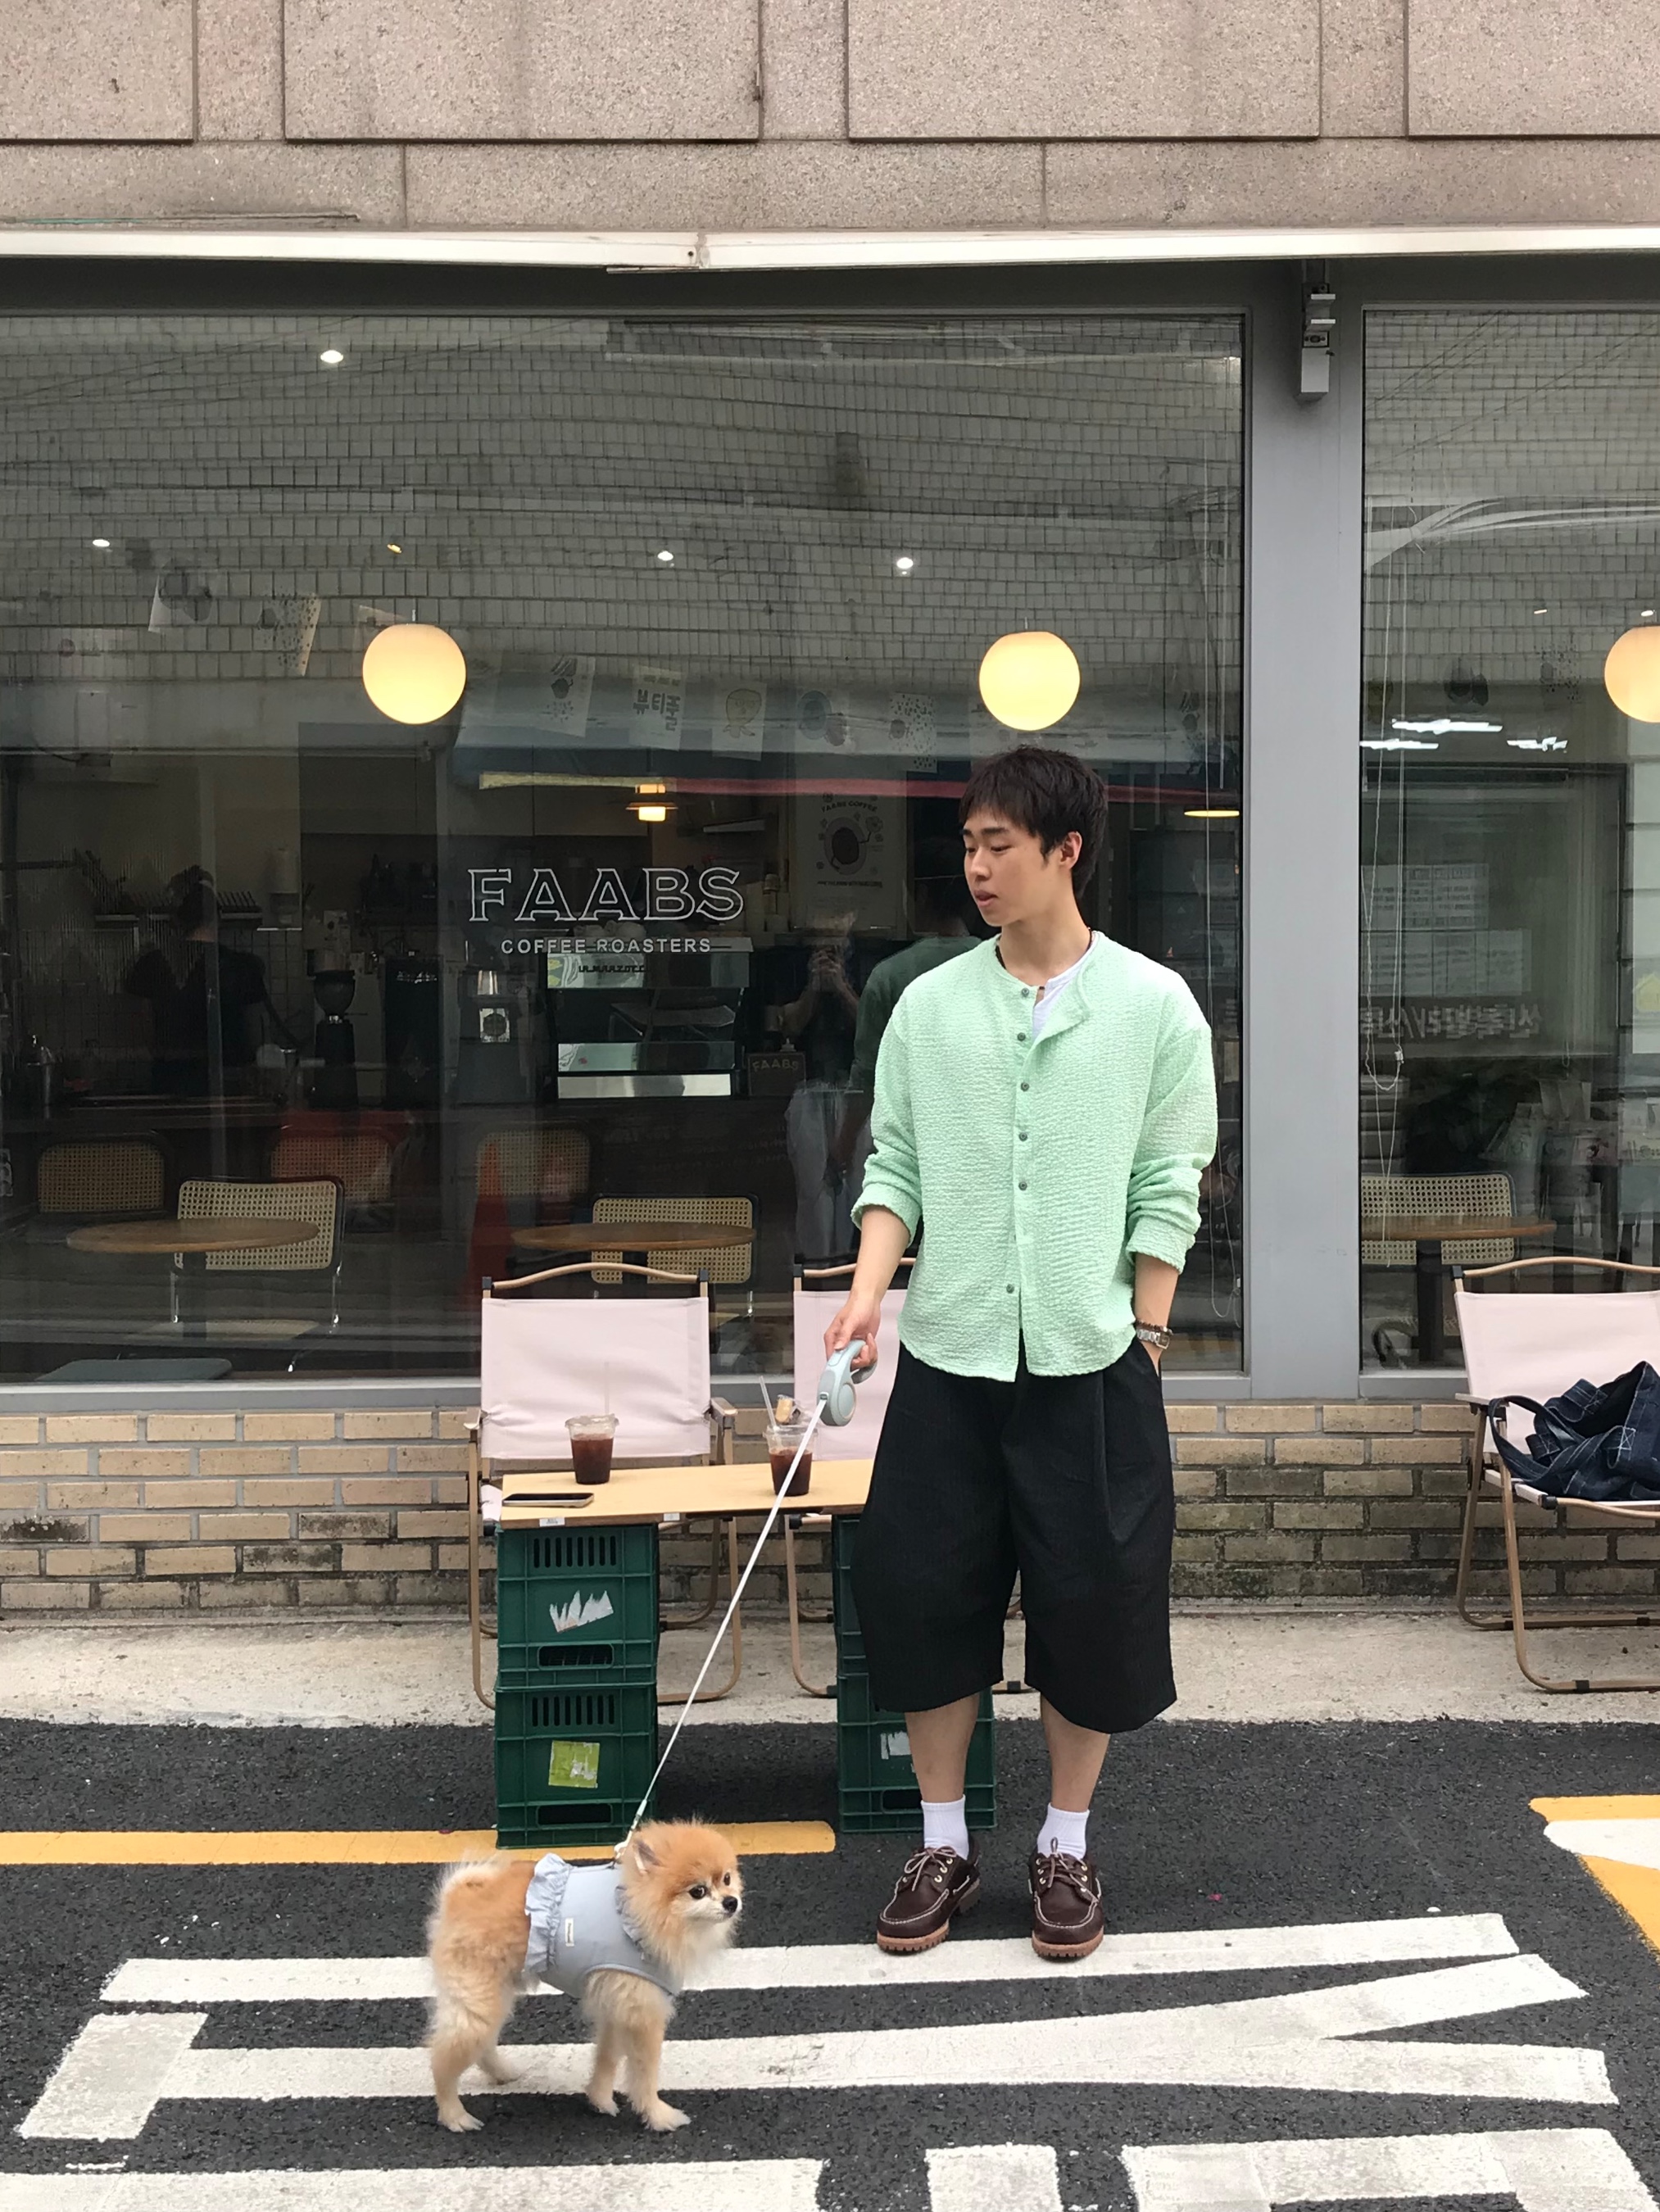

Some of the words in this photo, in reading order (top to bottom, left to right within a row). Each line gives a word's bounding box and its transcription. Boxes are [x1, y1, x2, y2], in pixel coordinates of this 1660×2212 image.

[467, 867, 744, 922] FAABS
[501, 938, 586, 954] COFFEE
[596, 937, 710, 953] ROASTERS
[751, 1058, 799, 1072] FAABS
